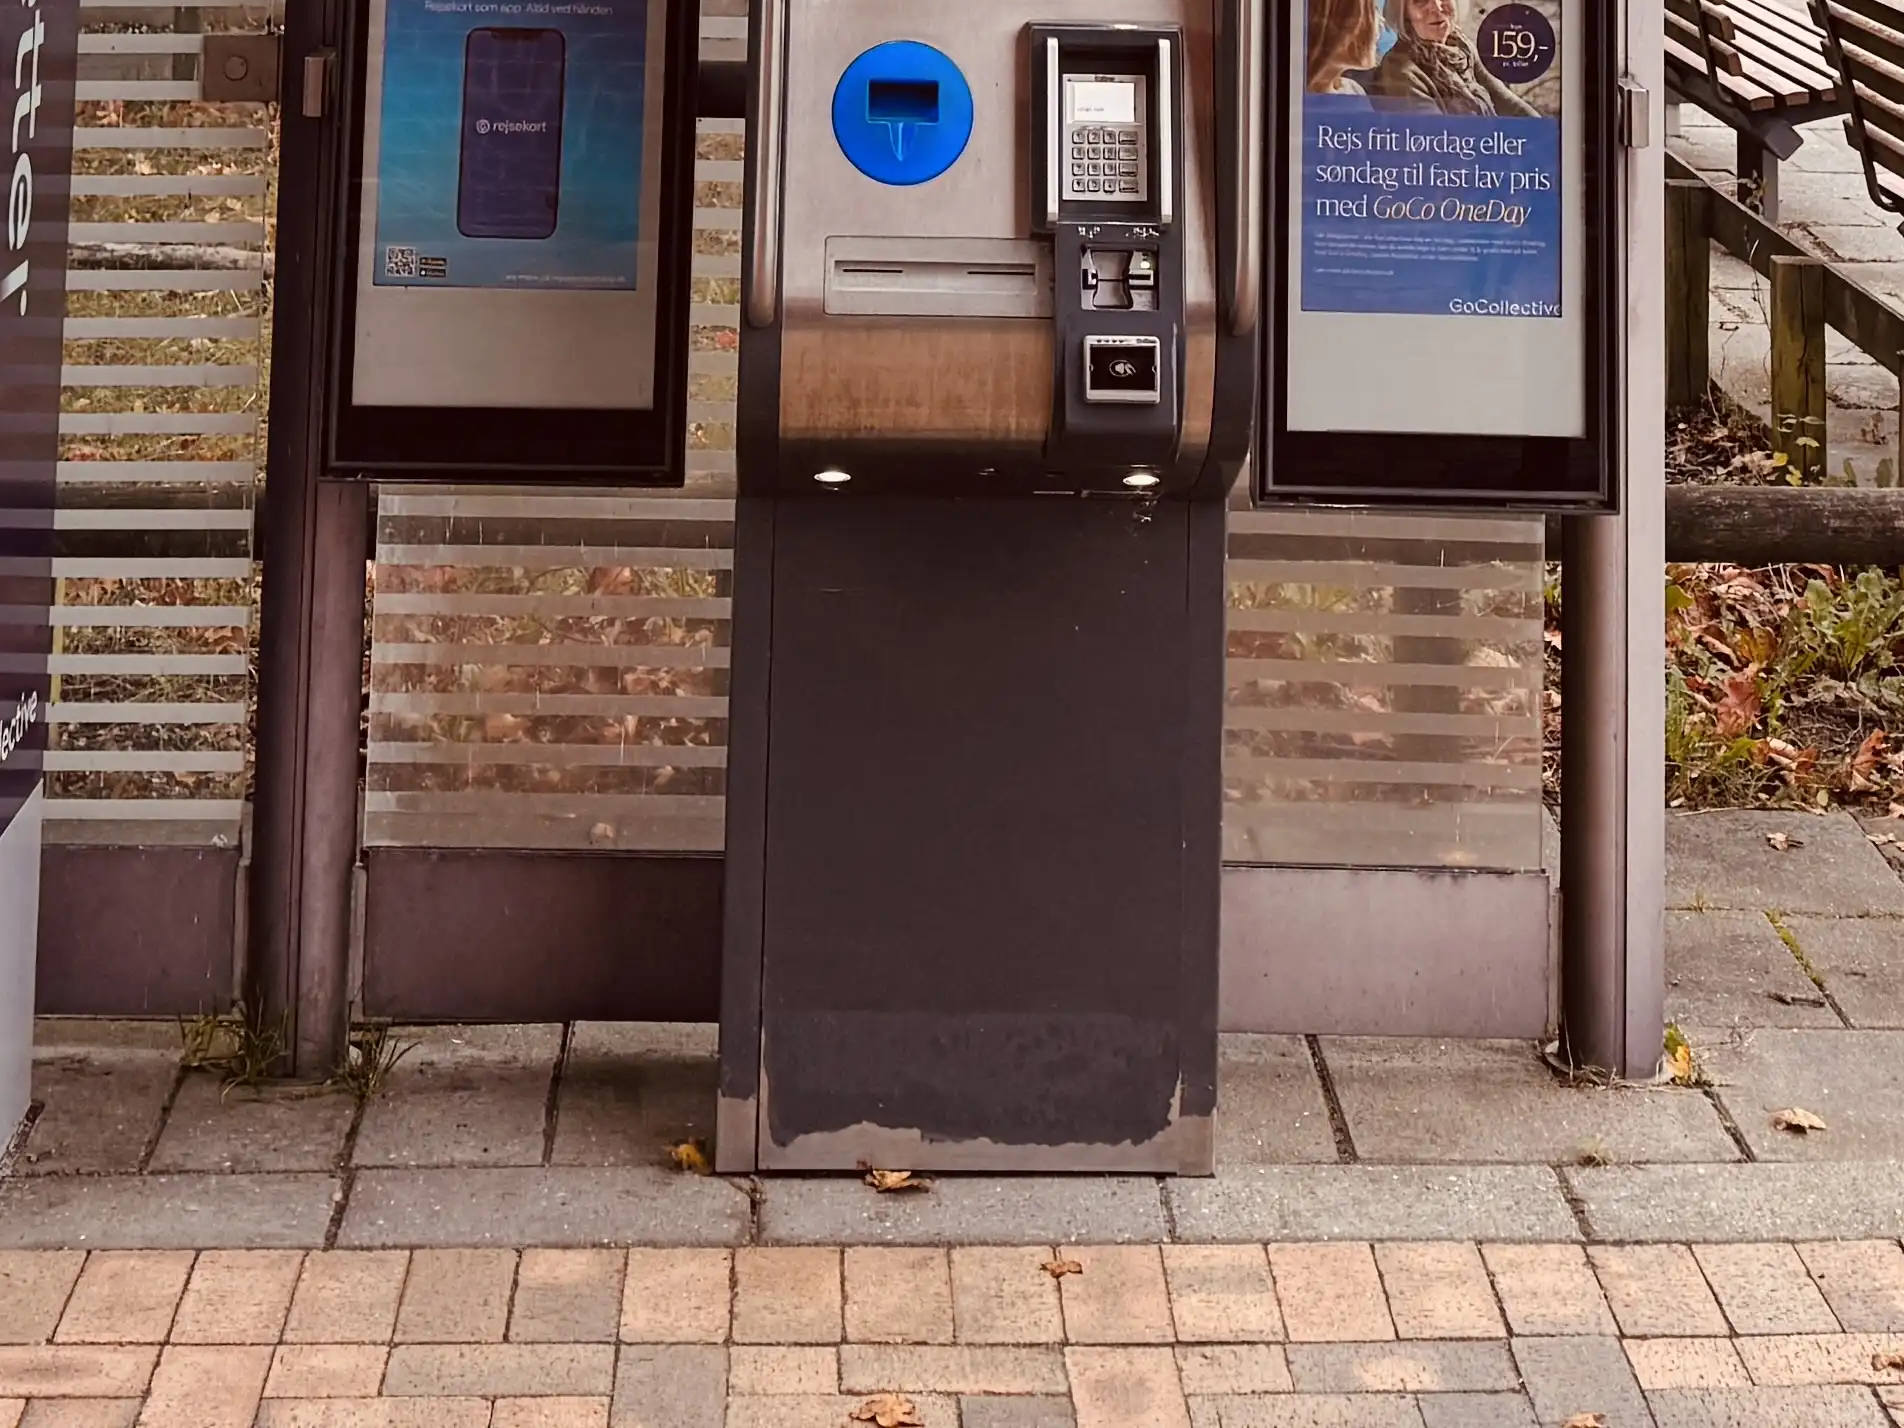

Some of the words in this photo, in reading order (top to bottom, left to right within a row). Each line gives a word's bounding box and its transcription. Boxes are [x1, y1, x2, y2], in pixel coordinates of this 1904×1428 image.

[493, 120, 546, 134] rejsekort
[1319, 126, 1361, 153] Rejs
[1369, 128, 1399, 150] frit
[1406, 129, 1475, 160] lørdag
[1480, 132, 1526, 155] eller
[1316, 161, 1398, 191] søndag
[1404, 163, 1422, 185] til
[1431, 164, 1468, 187] fast
[1476, 165, 1504, 188] lav
[1511, 168, 1550, 194] pris
[1317, 195, 1366, 217] med
[1374, 196, 1435, 219] GoCo
[1441, 199, 1531, 227] OneDay
